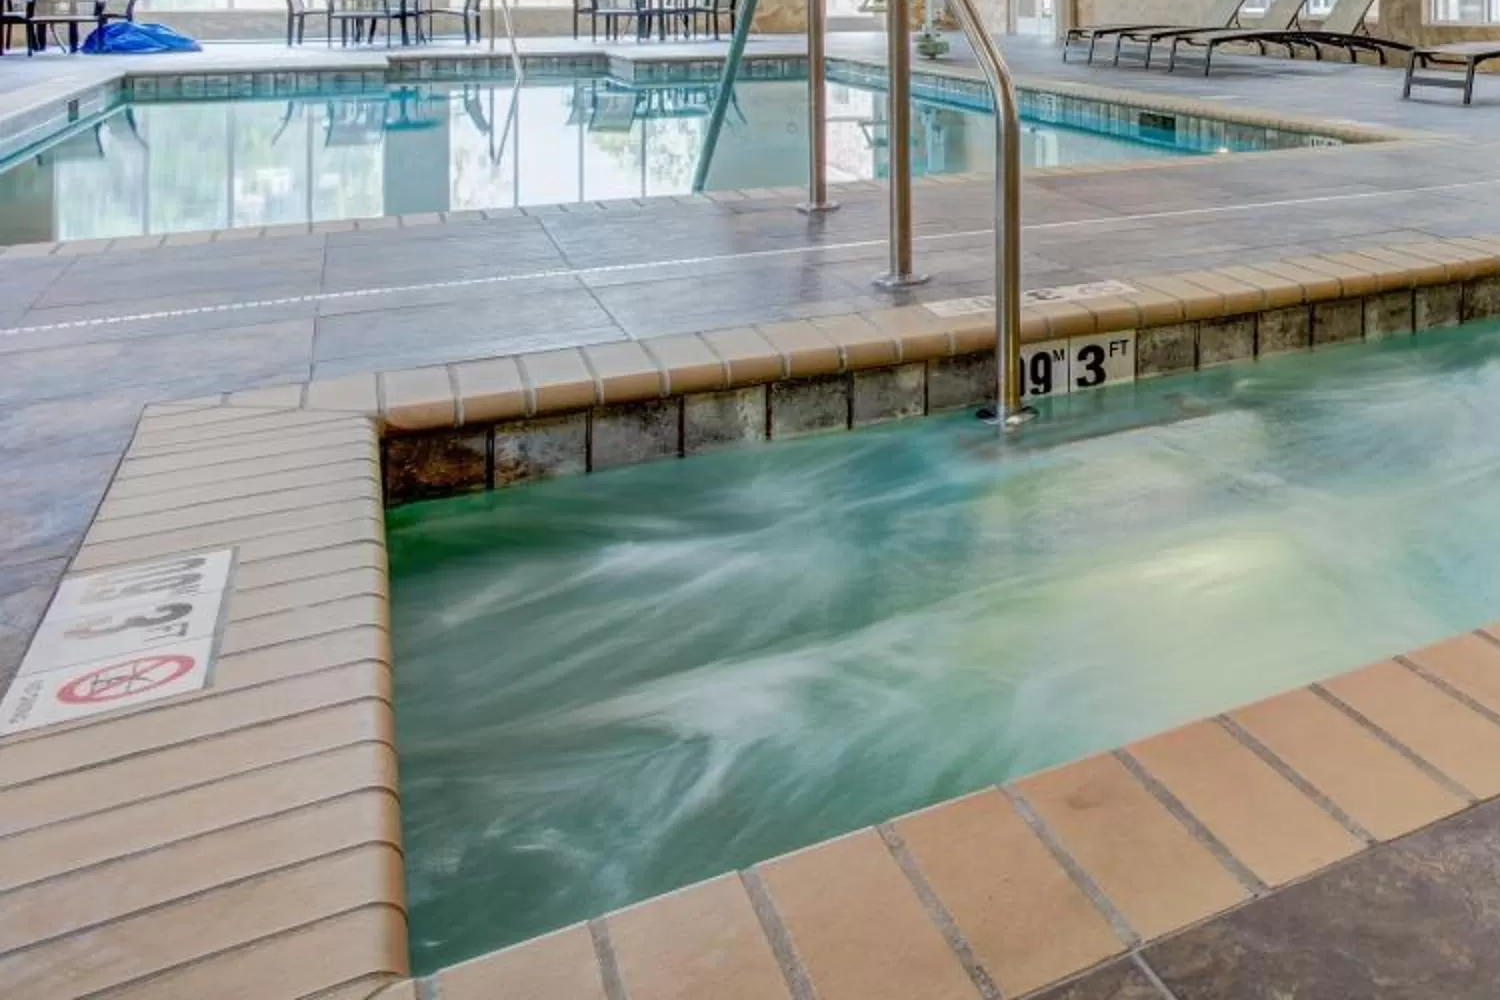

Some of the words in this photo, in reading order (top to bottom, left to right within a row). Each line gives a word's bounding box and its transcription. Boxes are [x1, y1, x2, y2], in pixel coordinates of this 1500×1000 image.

[1020, 351, 1052, 396] 9
[1076, 344, 1107, 387] 3
[1109, 339, 1130, 358] FT
